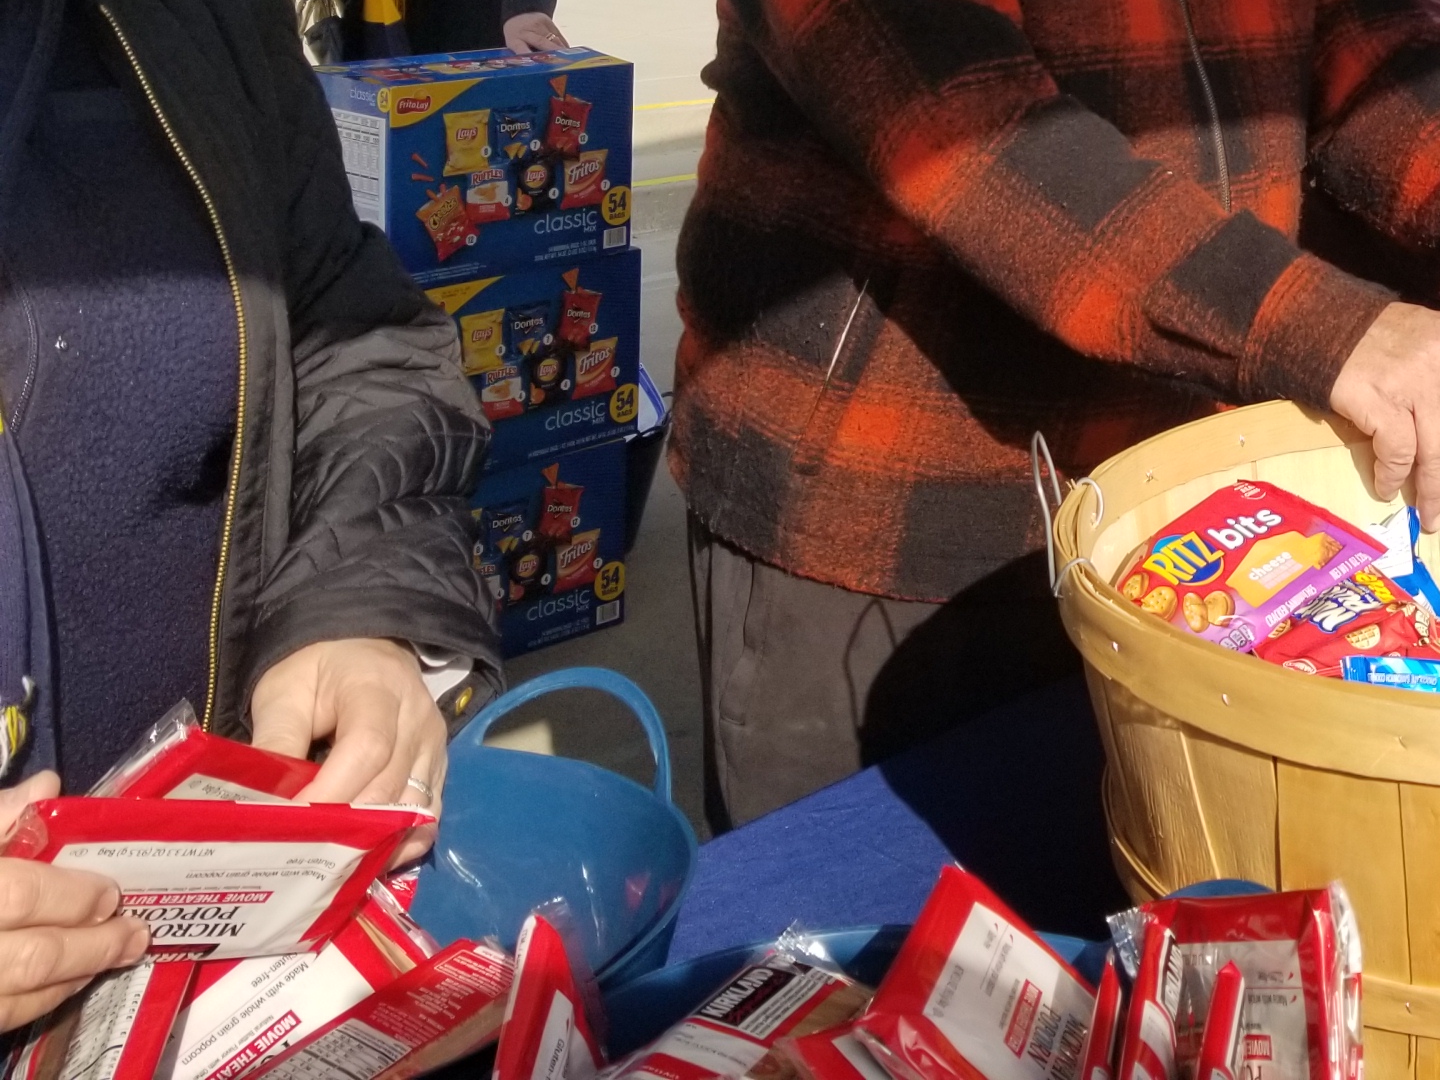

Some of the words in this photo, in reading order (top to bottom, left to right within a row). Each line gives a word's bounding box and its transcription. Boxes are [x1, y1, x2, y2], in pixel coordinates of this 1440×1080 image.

[501, 122, 531, 133] Doritos
[555, 116, 580, 128] Doritos
[568, 159, 600, 184] Fritos
[608, 193, 627, 213] 54
[534, 208, 598, 235] classic
[609, 212, 626, 221] BAGS
[583, 225, 597, 233] MIX
[514, 318, 543, 329] Doritos
[580, 349, 610, 374] Fritos
[616, 388, 634, 411] 54
[545, 401, 605, 431] classic
[592, 417, 605, 425] MIX
[492, 514, 522, 529] Doritos
[1142, 531, 1225, 585] RITZ
[1207, 508, 1283, 551] bits
[561, 540, 592, 569] Fritos
[1249, 551, 1292, 581] cheese
[601, 566, 619, 589] 54
[526, 589, 590, 621] classic
[97, 846, 115, 857] Bag
[128, 847, 151, 857] (93.5
[152, 848, 166, 857] OZ
[166, 848, 181, 857] 3.3
[183, 848, 198, 857] WT
[198, 848, 215, 857] NET
[286, 858, 336, 869] Gluten-free
[186, 871, 224, 880] popcorn
[226, 871, 250, 880] grain
[252, 871, 279, 879] whole
[302, 871, 327, 881] Made
[160, 893, 220, 904] THEATER
[223, 892, 268, 903] MOVIE
[150, 923, 246, 938] MICRO
[284, 961, 309, 982] Made
[265, 981, 285, 998] with
[700, 968, 774, 1018] KIRKLAND
[240, 997, 266, 1019] whole
[220, 1017, 240, 1037] grain
[254, 1014, 297, 1052] MOVIE
[182, 1035, 217, 1065] popcorn
